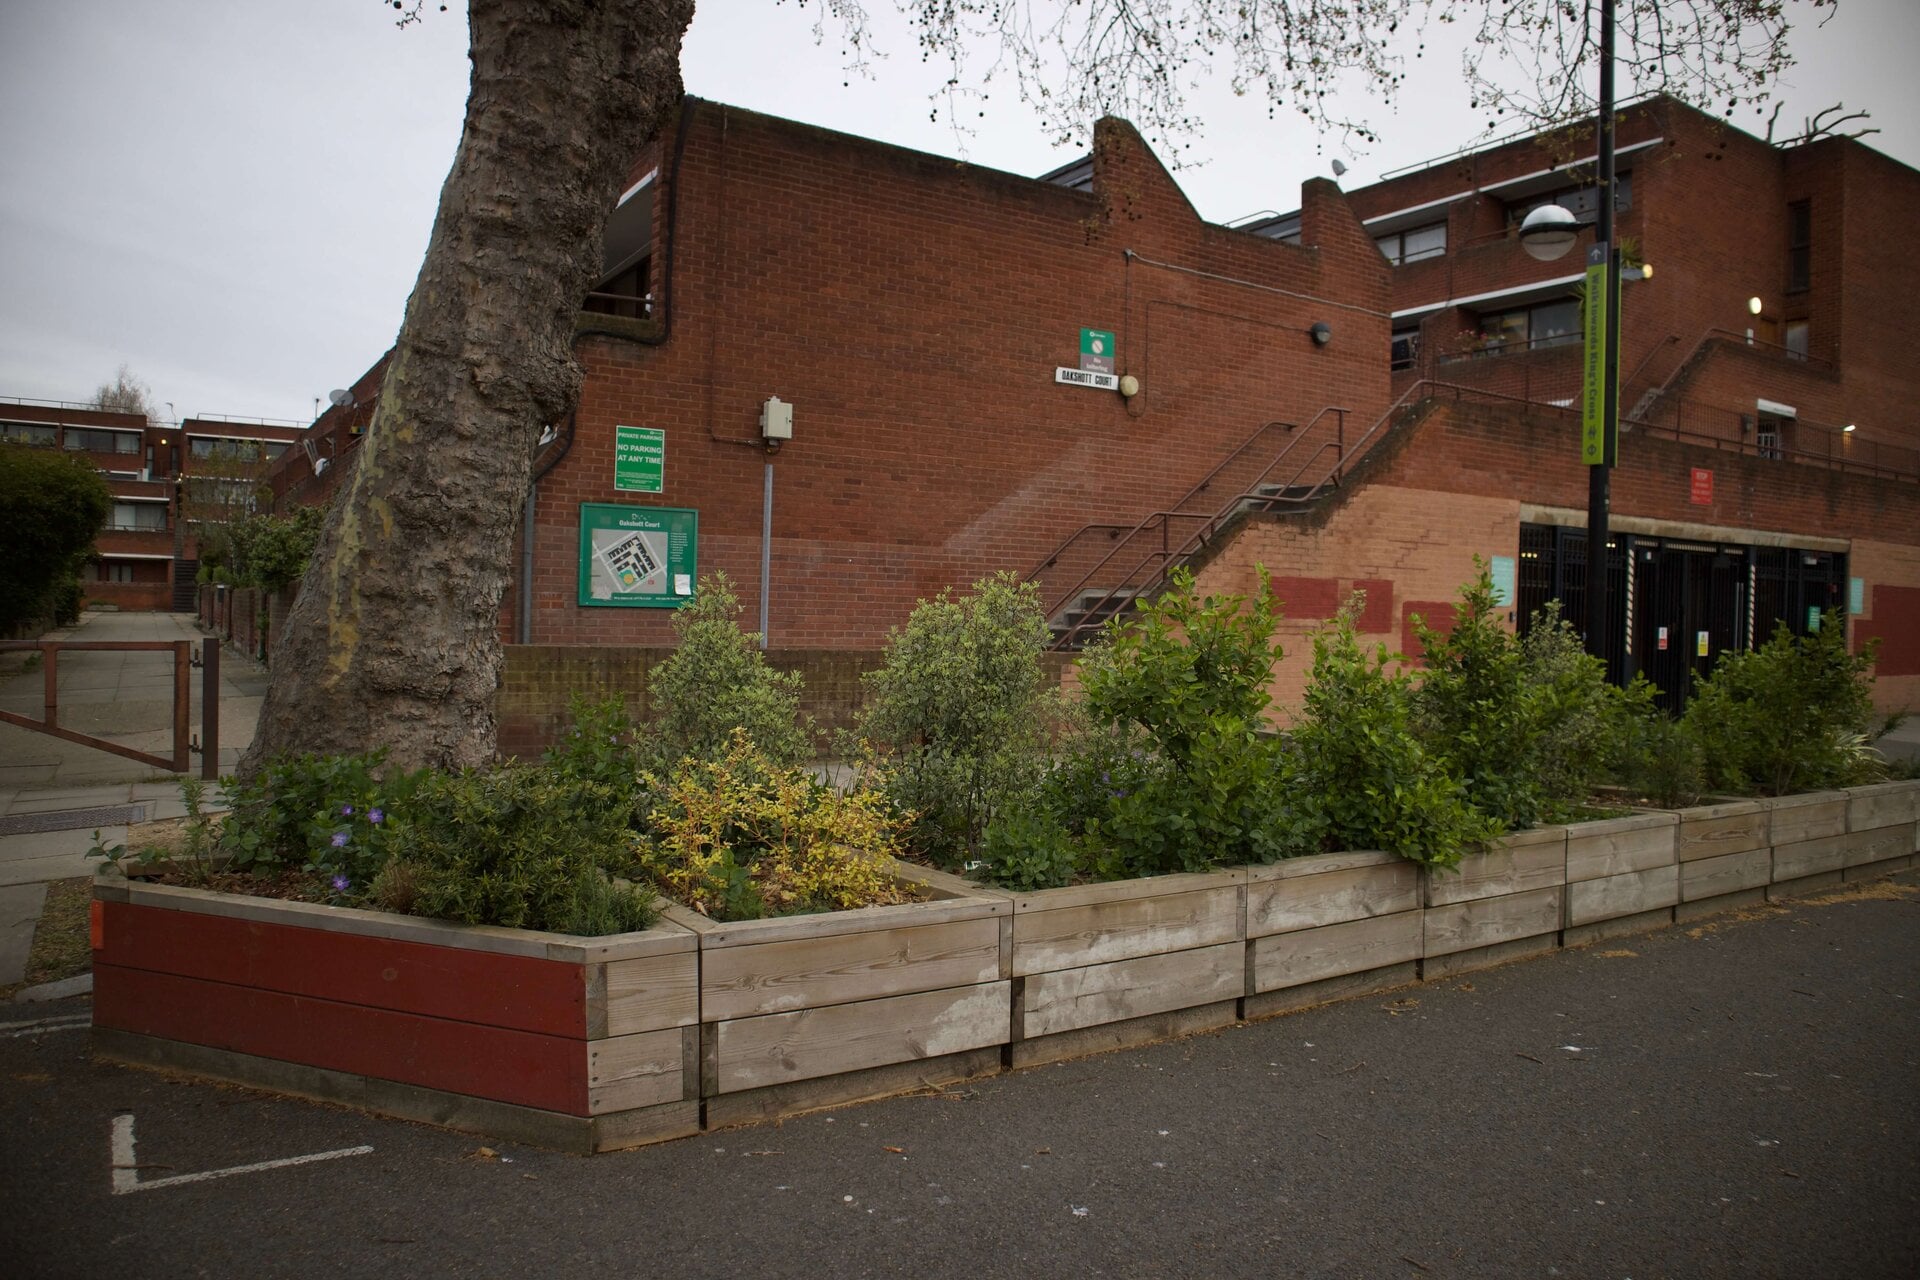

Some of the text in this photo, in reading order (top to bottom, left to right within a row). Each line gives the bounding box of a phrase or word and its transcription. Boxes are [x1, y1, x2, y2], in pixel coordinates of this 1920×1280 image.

[1588, 273, 1600, 420] Walk towards King's Cross
[1062, 370, 1112, 387] OAKSHOTT COURT
[630, 445, 662, 454] PARKING
[628, 455, 643, 463] ANY
[645, 456, 661, 465] TIME
[619, 519, 660, 528] Oakshott Court
